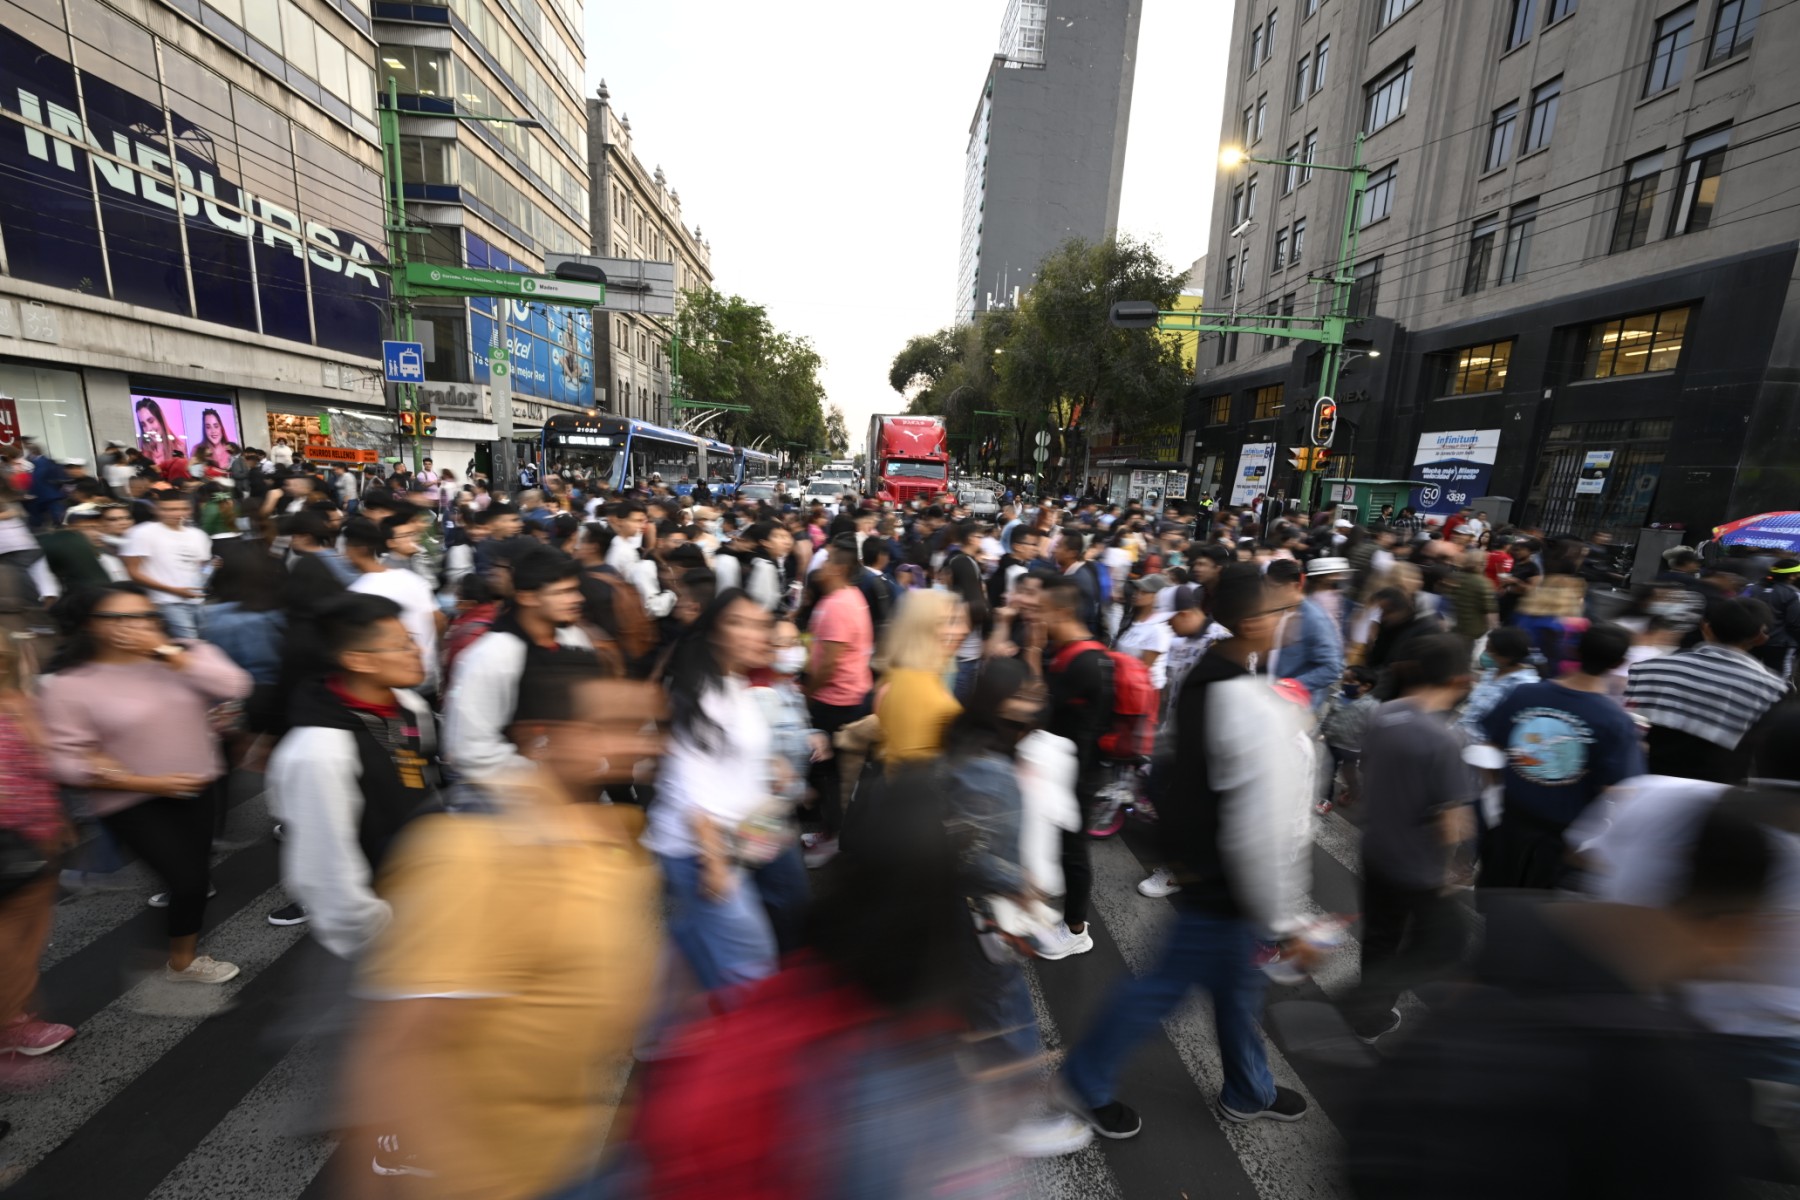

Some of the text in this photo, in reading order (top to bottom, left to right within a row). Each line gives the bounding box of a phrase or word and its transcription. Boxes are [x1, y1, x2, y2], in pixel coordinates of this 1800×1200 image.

[17, 88, 380, 288] INBURSA
[539, 284, 559, 292] Madero
[507, 338, 530, 359] elcel
[535, 370, 545, 382] Red
[417, 385, 479, 407] irador
[1437, 435, 1478, 444] infinitum
[309, 448, 331, 458] CHURROS
[331, 450, 356, 460] RELLENOS
[1423, 488, 1439, 500] 50
